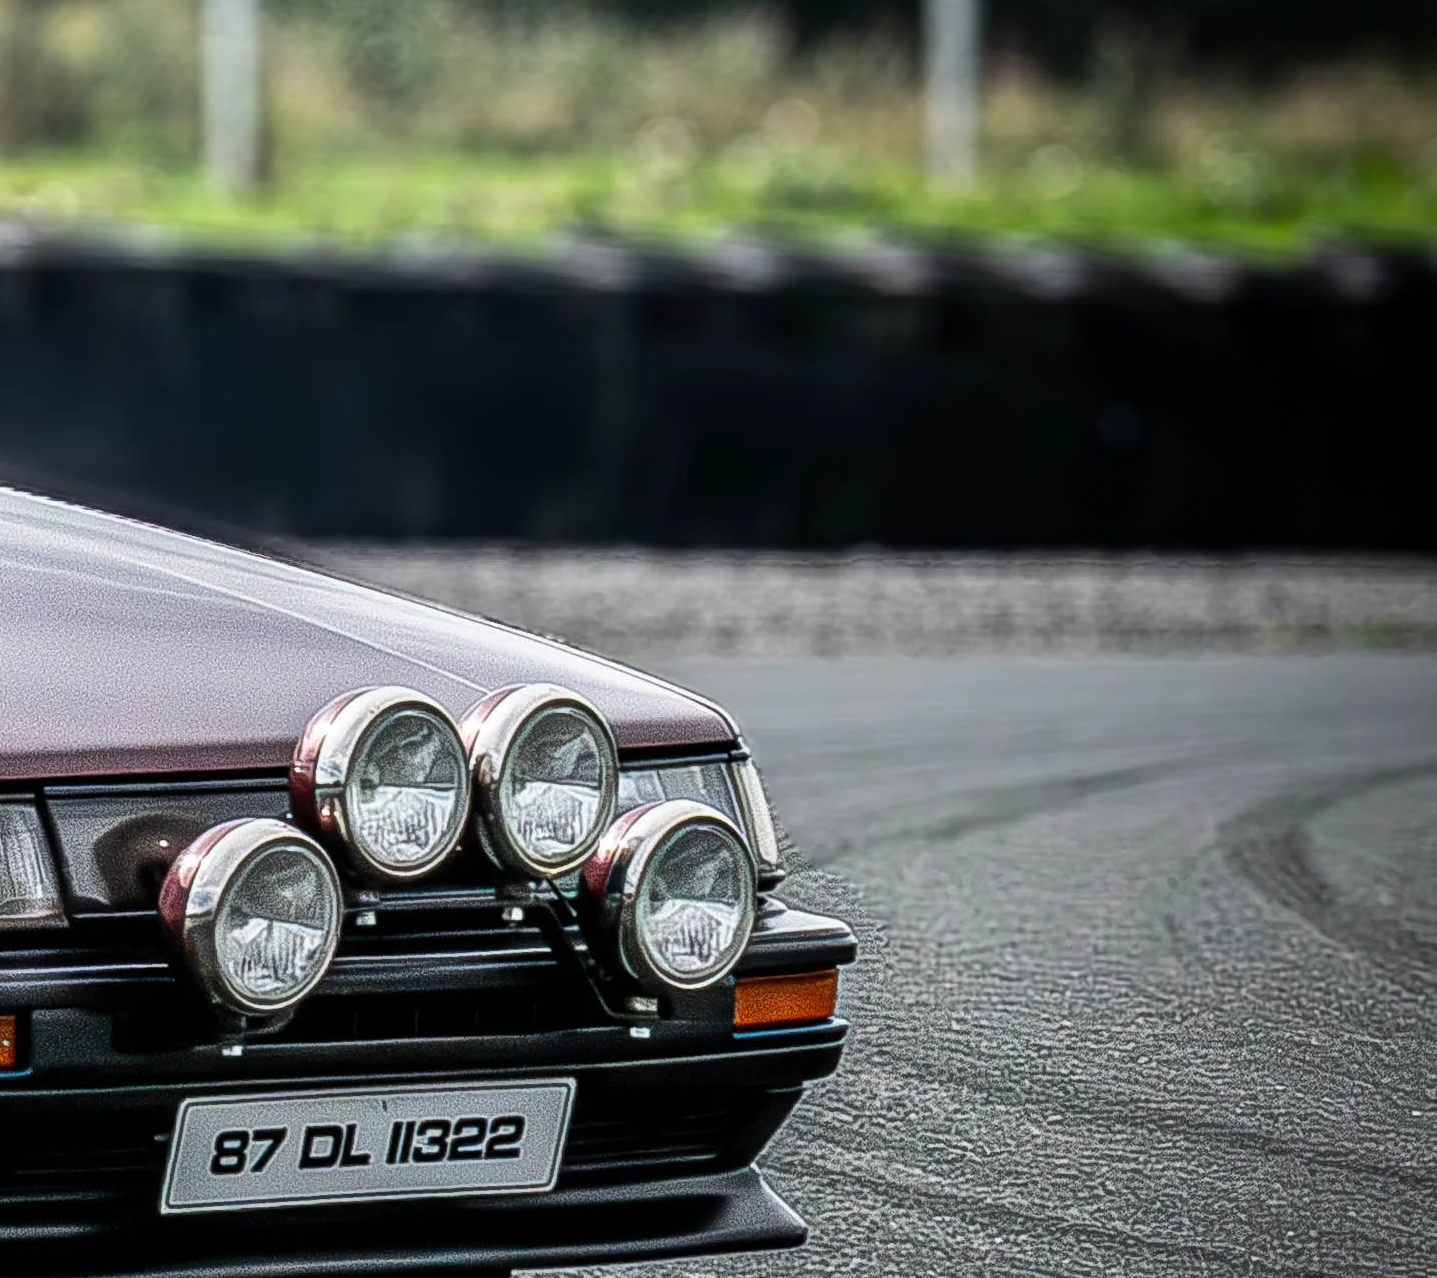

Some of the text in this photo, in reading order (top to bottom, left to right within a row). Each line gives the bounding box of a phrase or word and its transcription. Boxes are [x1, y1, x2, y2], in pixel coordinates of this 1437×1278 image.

[209, 1115, 525, 1175] 87 DL 11322
